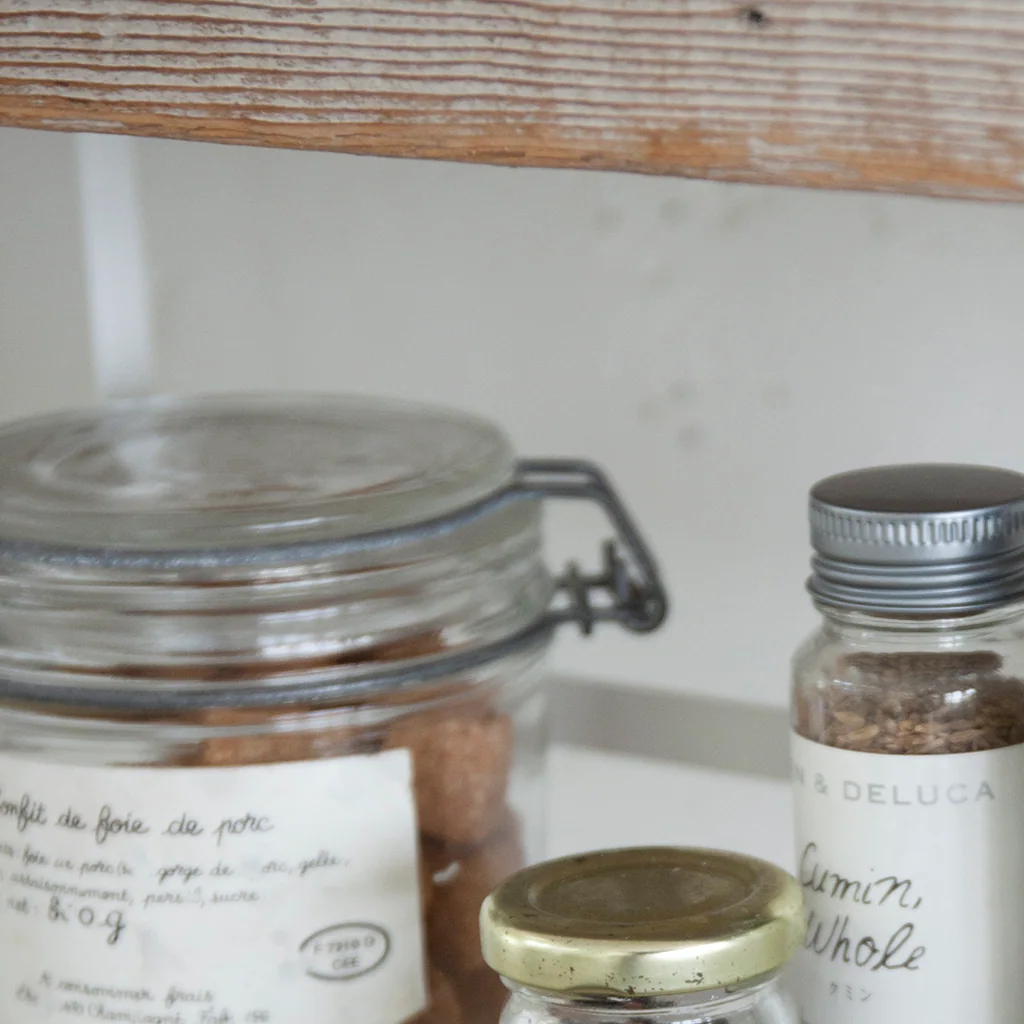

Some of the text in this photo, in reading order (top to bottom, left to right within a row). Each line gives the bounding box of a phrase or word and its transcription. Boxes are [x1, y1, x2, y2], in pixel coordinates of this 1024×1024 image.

[843, 780, 995, 806] DELUCA
[55, 806, 87, 830] de
[93, 804, 149, 845] foie
[160, 812, 205, 837] de
[213, 811, 275, 848] porc
[804, 910, 927, 972] Whole
